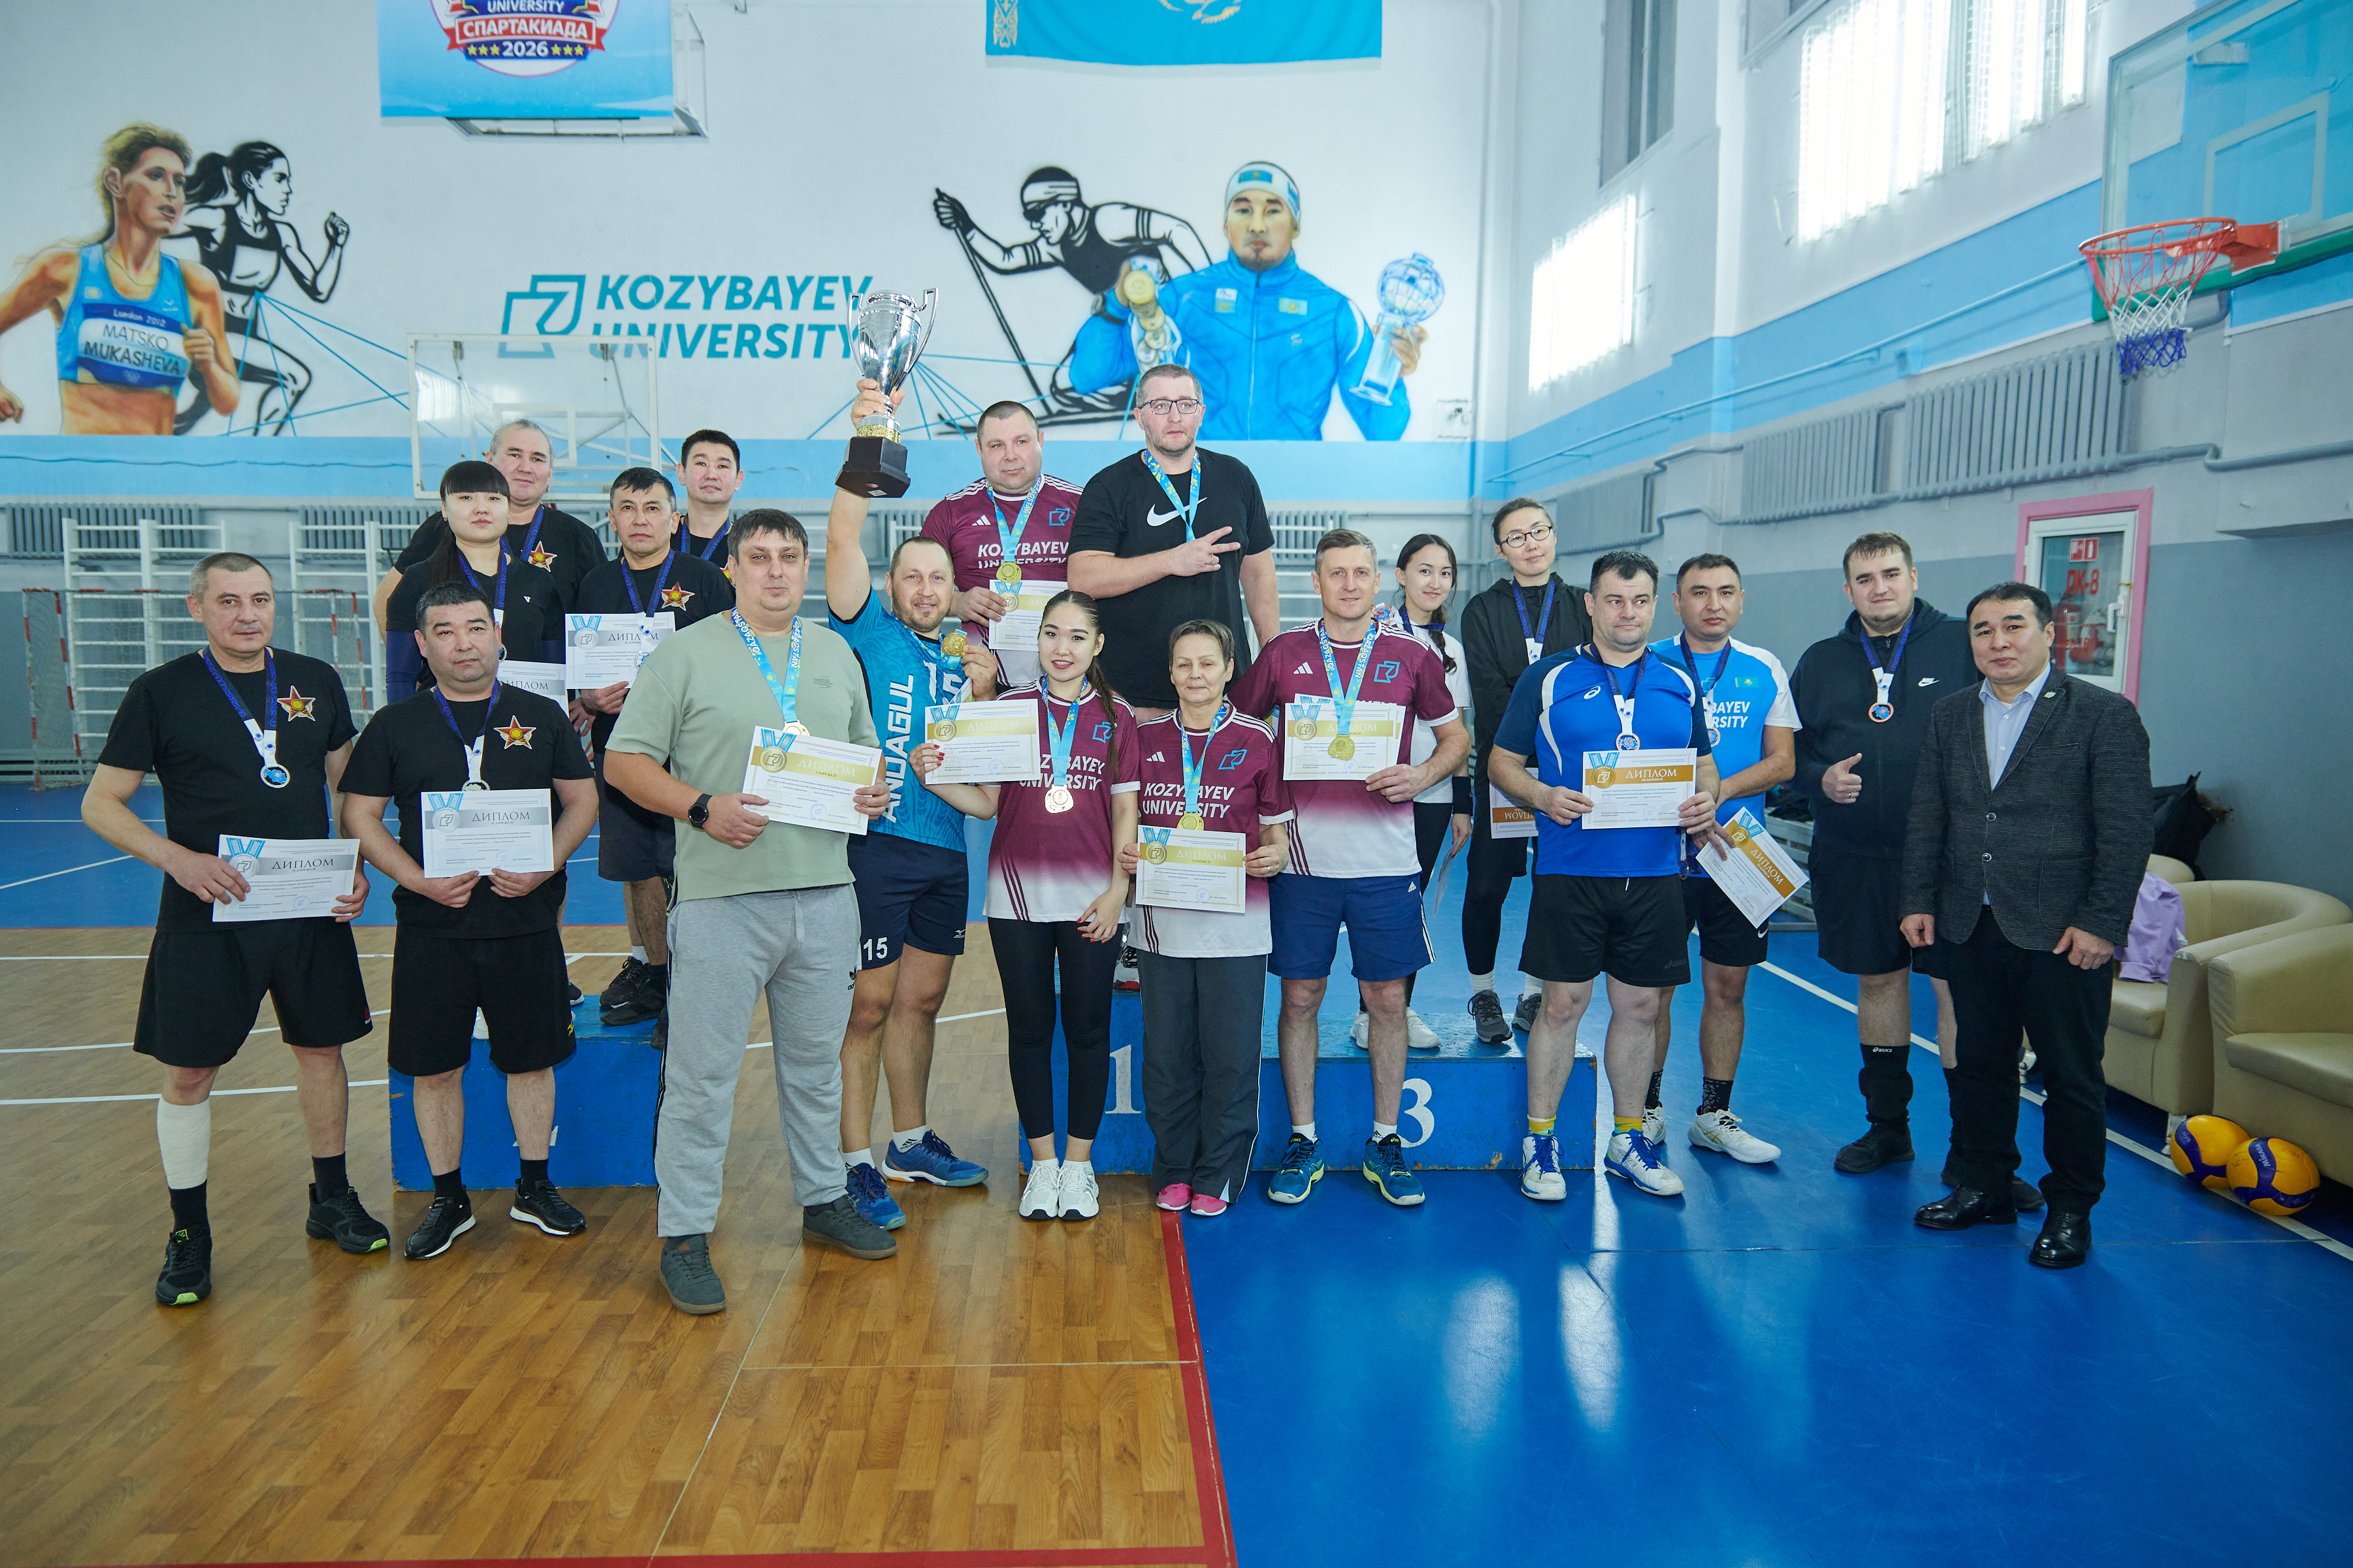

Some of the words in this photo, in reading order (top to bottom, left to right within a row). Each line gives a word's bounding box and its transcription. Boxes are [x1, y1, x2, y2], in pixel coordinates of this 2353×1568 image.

[487, 0, 564, 14] UNIVERSITY
[462, 18, 589, 39] СПАРТАКИАДА
[502, 40, 549, 57] 2026
[596, 275, 873, 311] KOZYBAYEV
[113, 308, 144, 321] London
[146, 315, 167, 327] 2012
[103, 325, 169, 351] MATSKO
[590, 323, 859, 359] UNIVERSITY
[84, 341, 180, 374] MUKASHEVA
[978, 541, 1069, 558] KOYBAYEV
[608, 633, 658, 641] ДИПЛМ
[731, 609, 760, 653] QAZAQSTAN
[790, 620, 801, 669] QAZAQSTAN
[1320, 626, 1334, 669] QAZAQSTAN
[1354, 633, 1374, 679] QAZAQSTAN
[506, 680, 549, 690] ИПЛОМ
[1712, 701, 1750, 714] BAYEV
[966, 720, 1019, 732] ДИПЛОМ
[1326, 723, 1377, 732] ДЛОМ
[1712, 716, 1748, 728] RSITY
[797, 758, 856, 777] ДИПЛОМ
[1625, 768, 1677, 779] ДИПЛОМ
[1144, 782, 1235, 801] KOZYAYEV
[471, 811, 530, 822] ДИПЛОМ
[1143, 800, 1230, 818] UNIVESITY
[271, 858, 334, 870] ДИПЛОМ
[1176, 850, 1227, 861] ДИПЛОМ
[1750, 849, 1784, 885] ДИПЛОМ
[863, 936, 888, 961] 15
[1105, 1044, 1142, 1114] 1
[1397, 1078, 1435, 1148] 3
